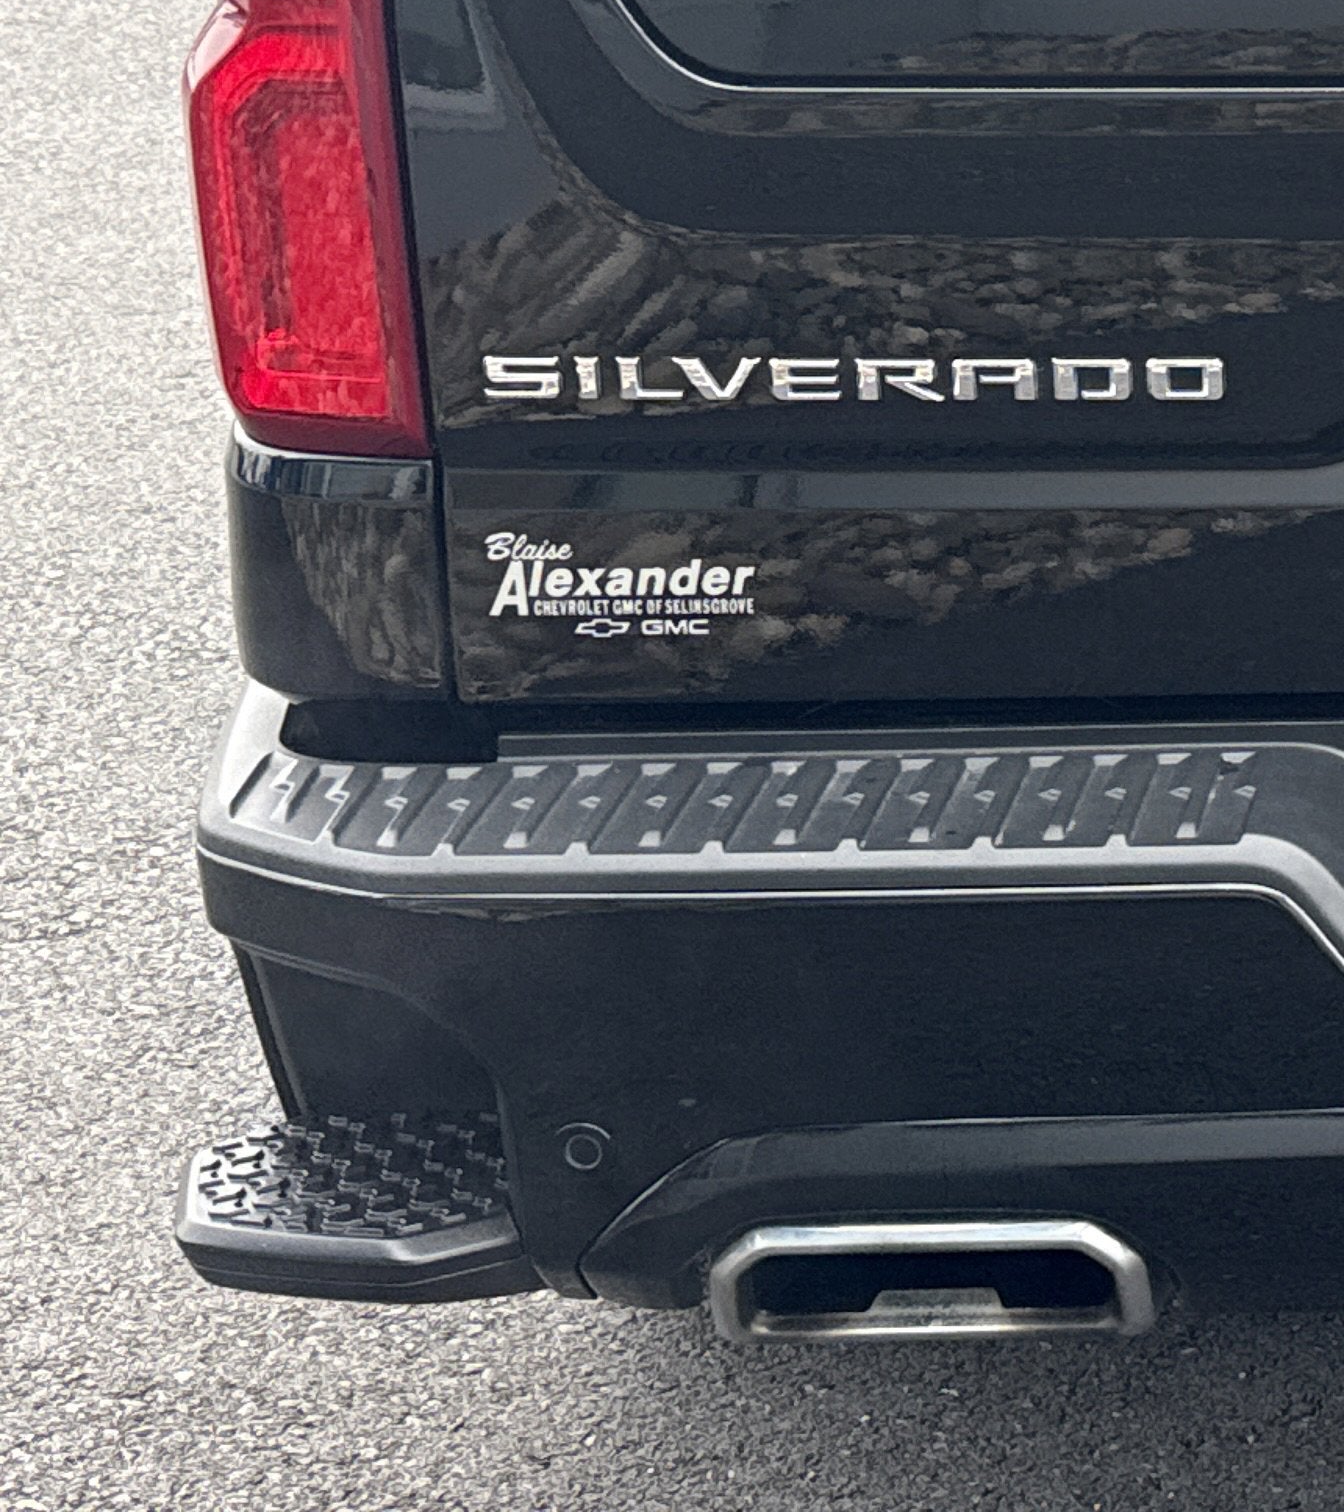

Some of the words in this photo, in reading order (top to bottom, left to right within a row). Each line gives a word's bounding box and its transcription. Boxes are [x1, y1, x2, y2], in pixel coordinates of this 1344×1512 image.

[482, 355, 1226, 402] SILVERADO
[484, 531, 574, 561] Blaise
[488, 558, 756, 617] Alexander
[533, 598, 609, 616] CHEVROLET
[612, 598, 643, 616] GMC
[646, 598, 662, 615] OF
[664, 597, 755, 616] SELINSGROVE
[640, 618, 710, 635] GMC
